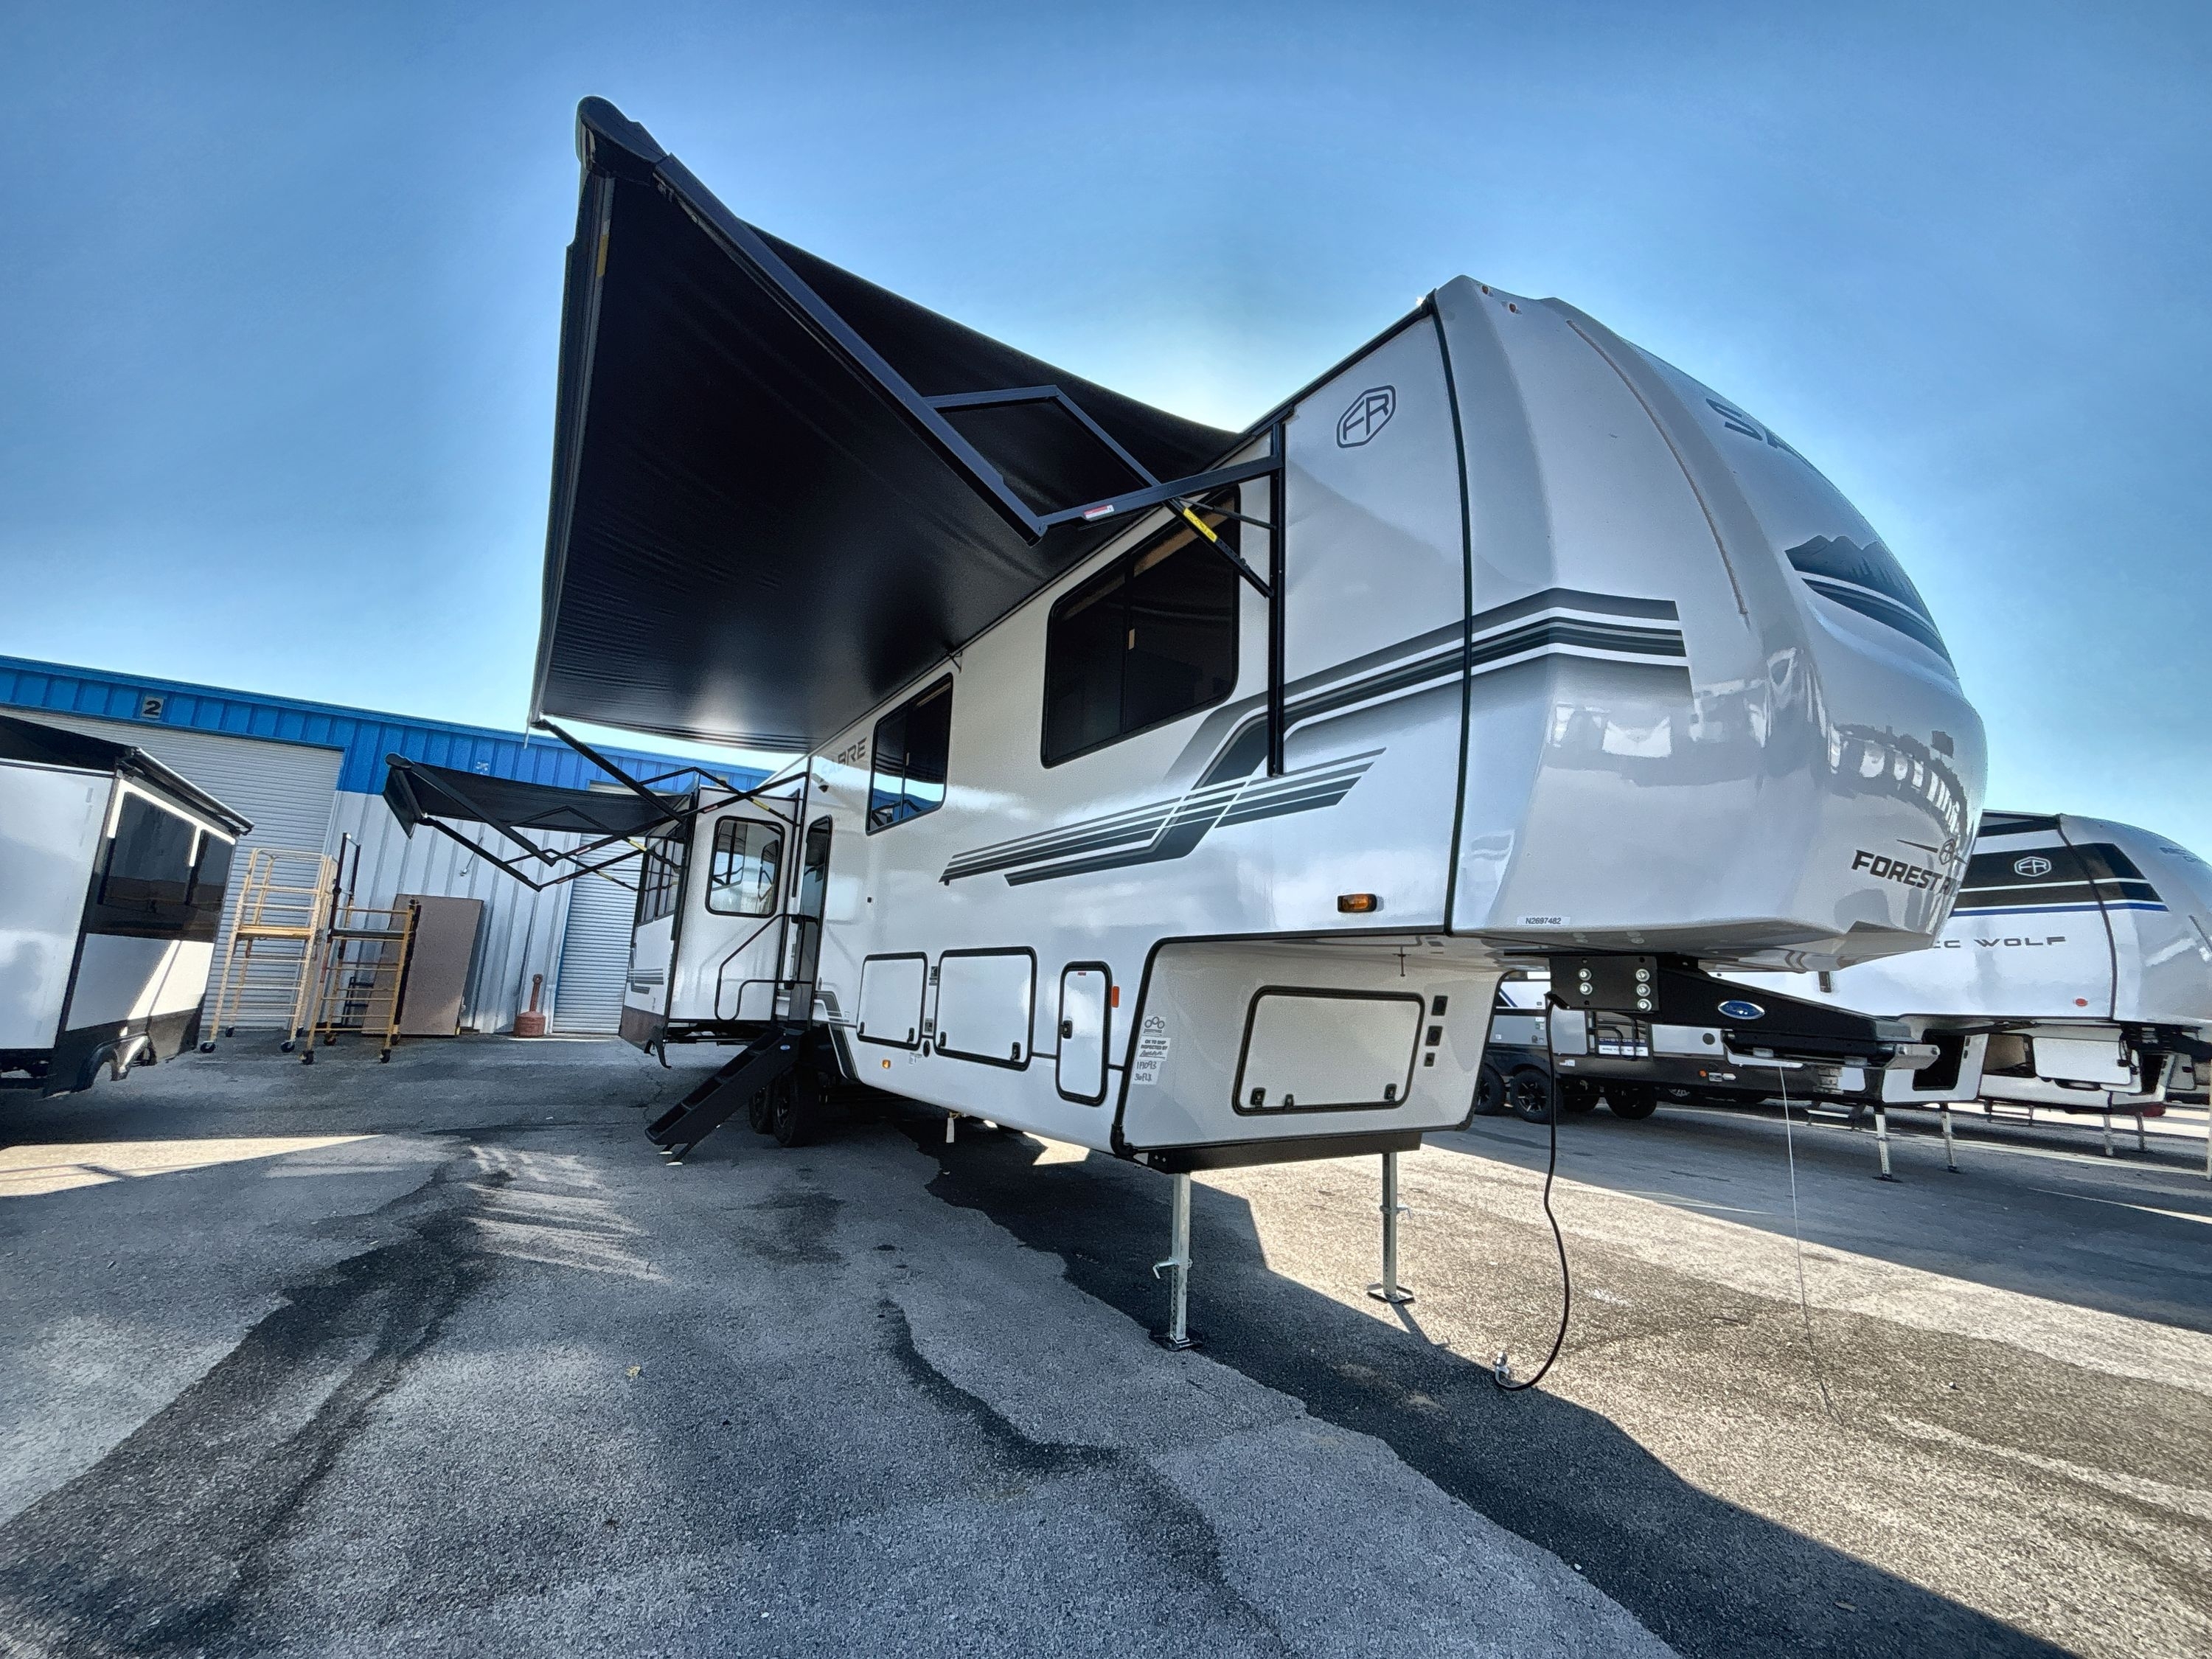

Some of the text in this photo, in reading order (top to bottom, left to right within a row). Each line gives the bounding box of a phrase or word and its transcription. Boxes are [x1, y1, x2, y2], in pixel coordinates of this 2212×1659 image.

[143, 700, 161, 716] 2
[1851, 849, 1944, 891] FOREST
[2017, 858, 2048, 874] FR
[1526, 917, 1562, 925] N2697482
[1973, 936, 2066, 947] WOLF
